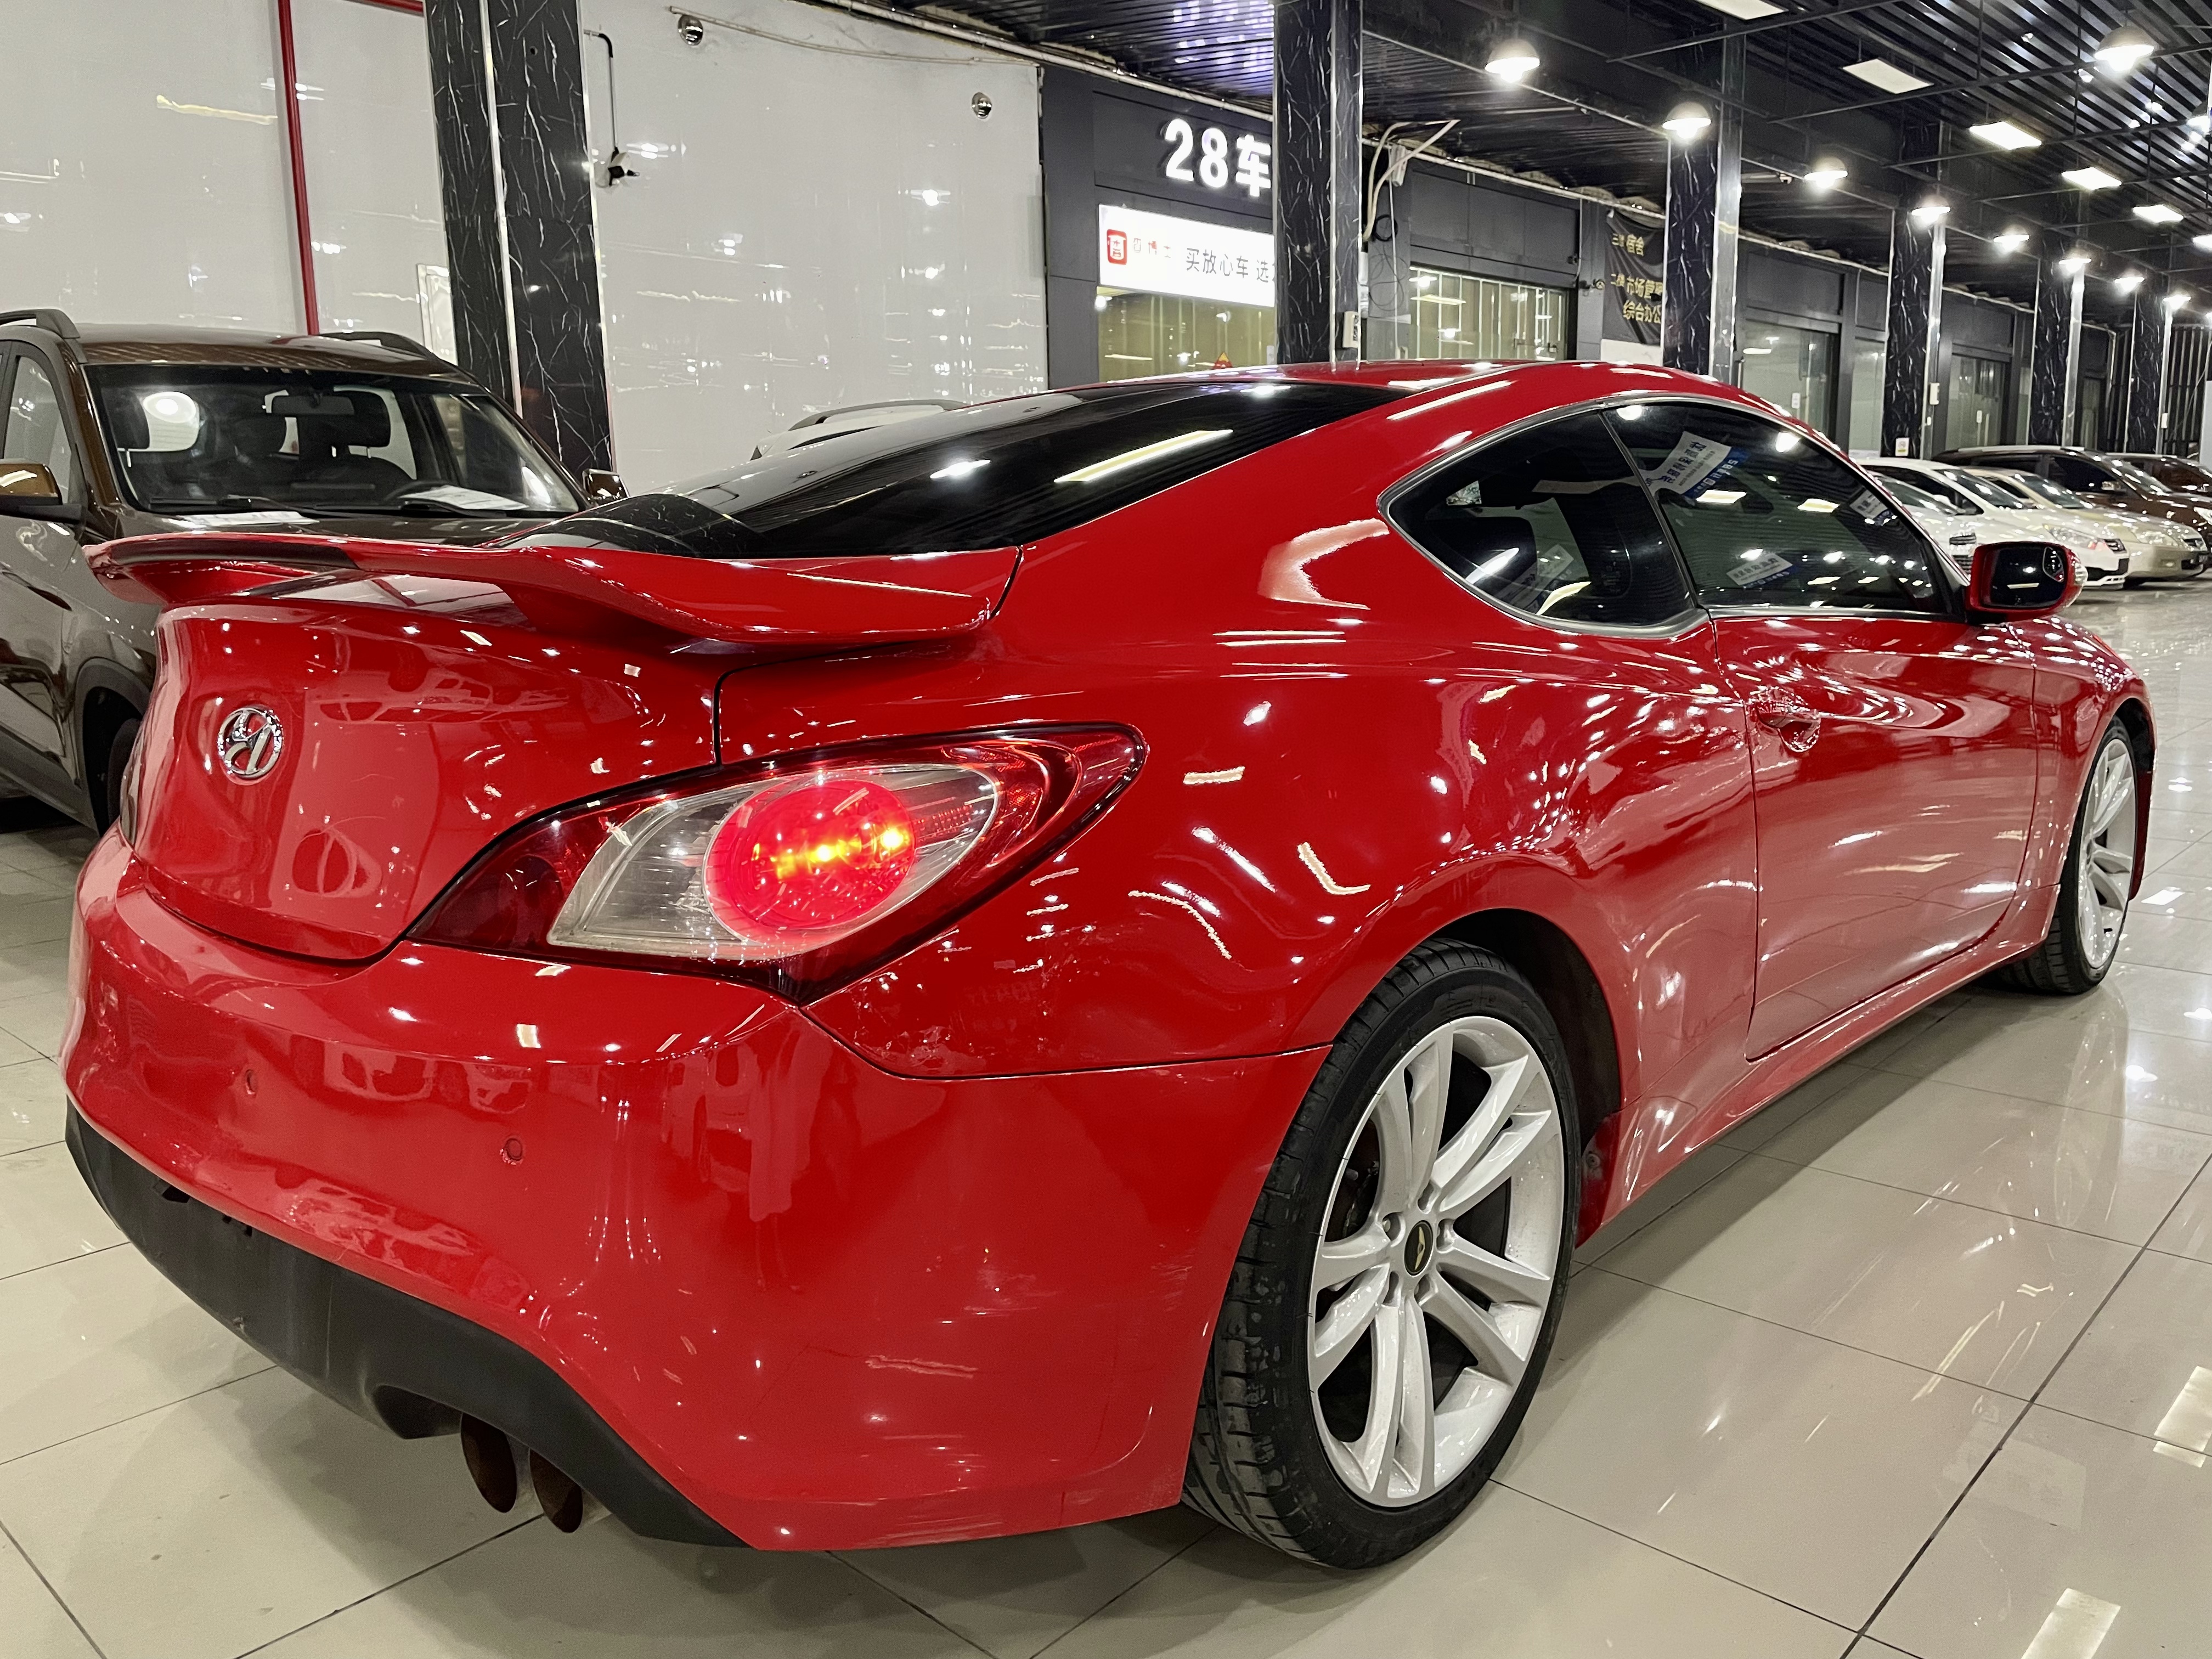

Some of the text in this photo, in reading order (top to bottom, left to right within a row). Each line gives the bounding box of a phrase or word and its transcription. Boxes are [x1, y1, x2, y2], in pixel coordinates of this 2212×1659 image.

[1164, 118, 1271, 197] 28车
[1186, 247, 1249, 278] 买放心车
[1256, 259, 1275, 283] 选
